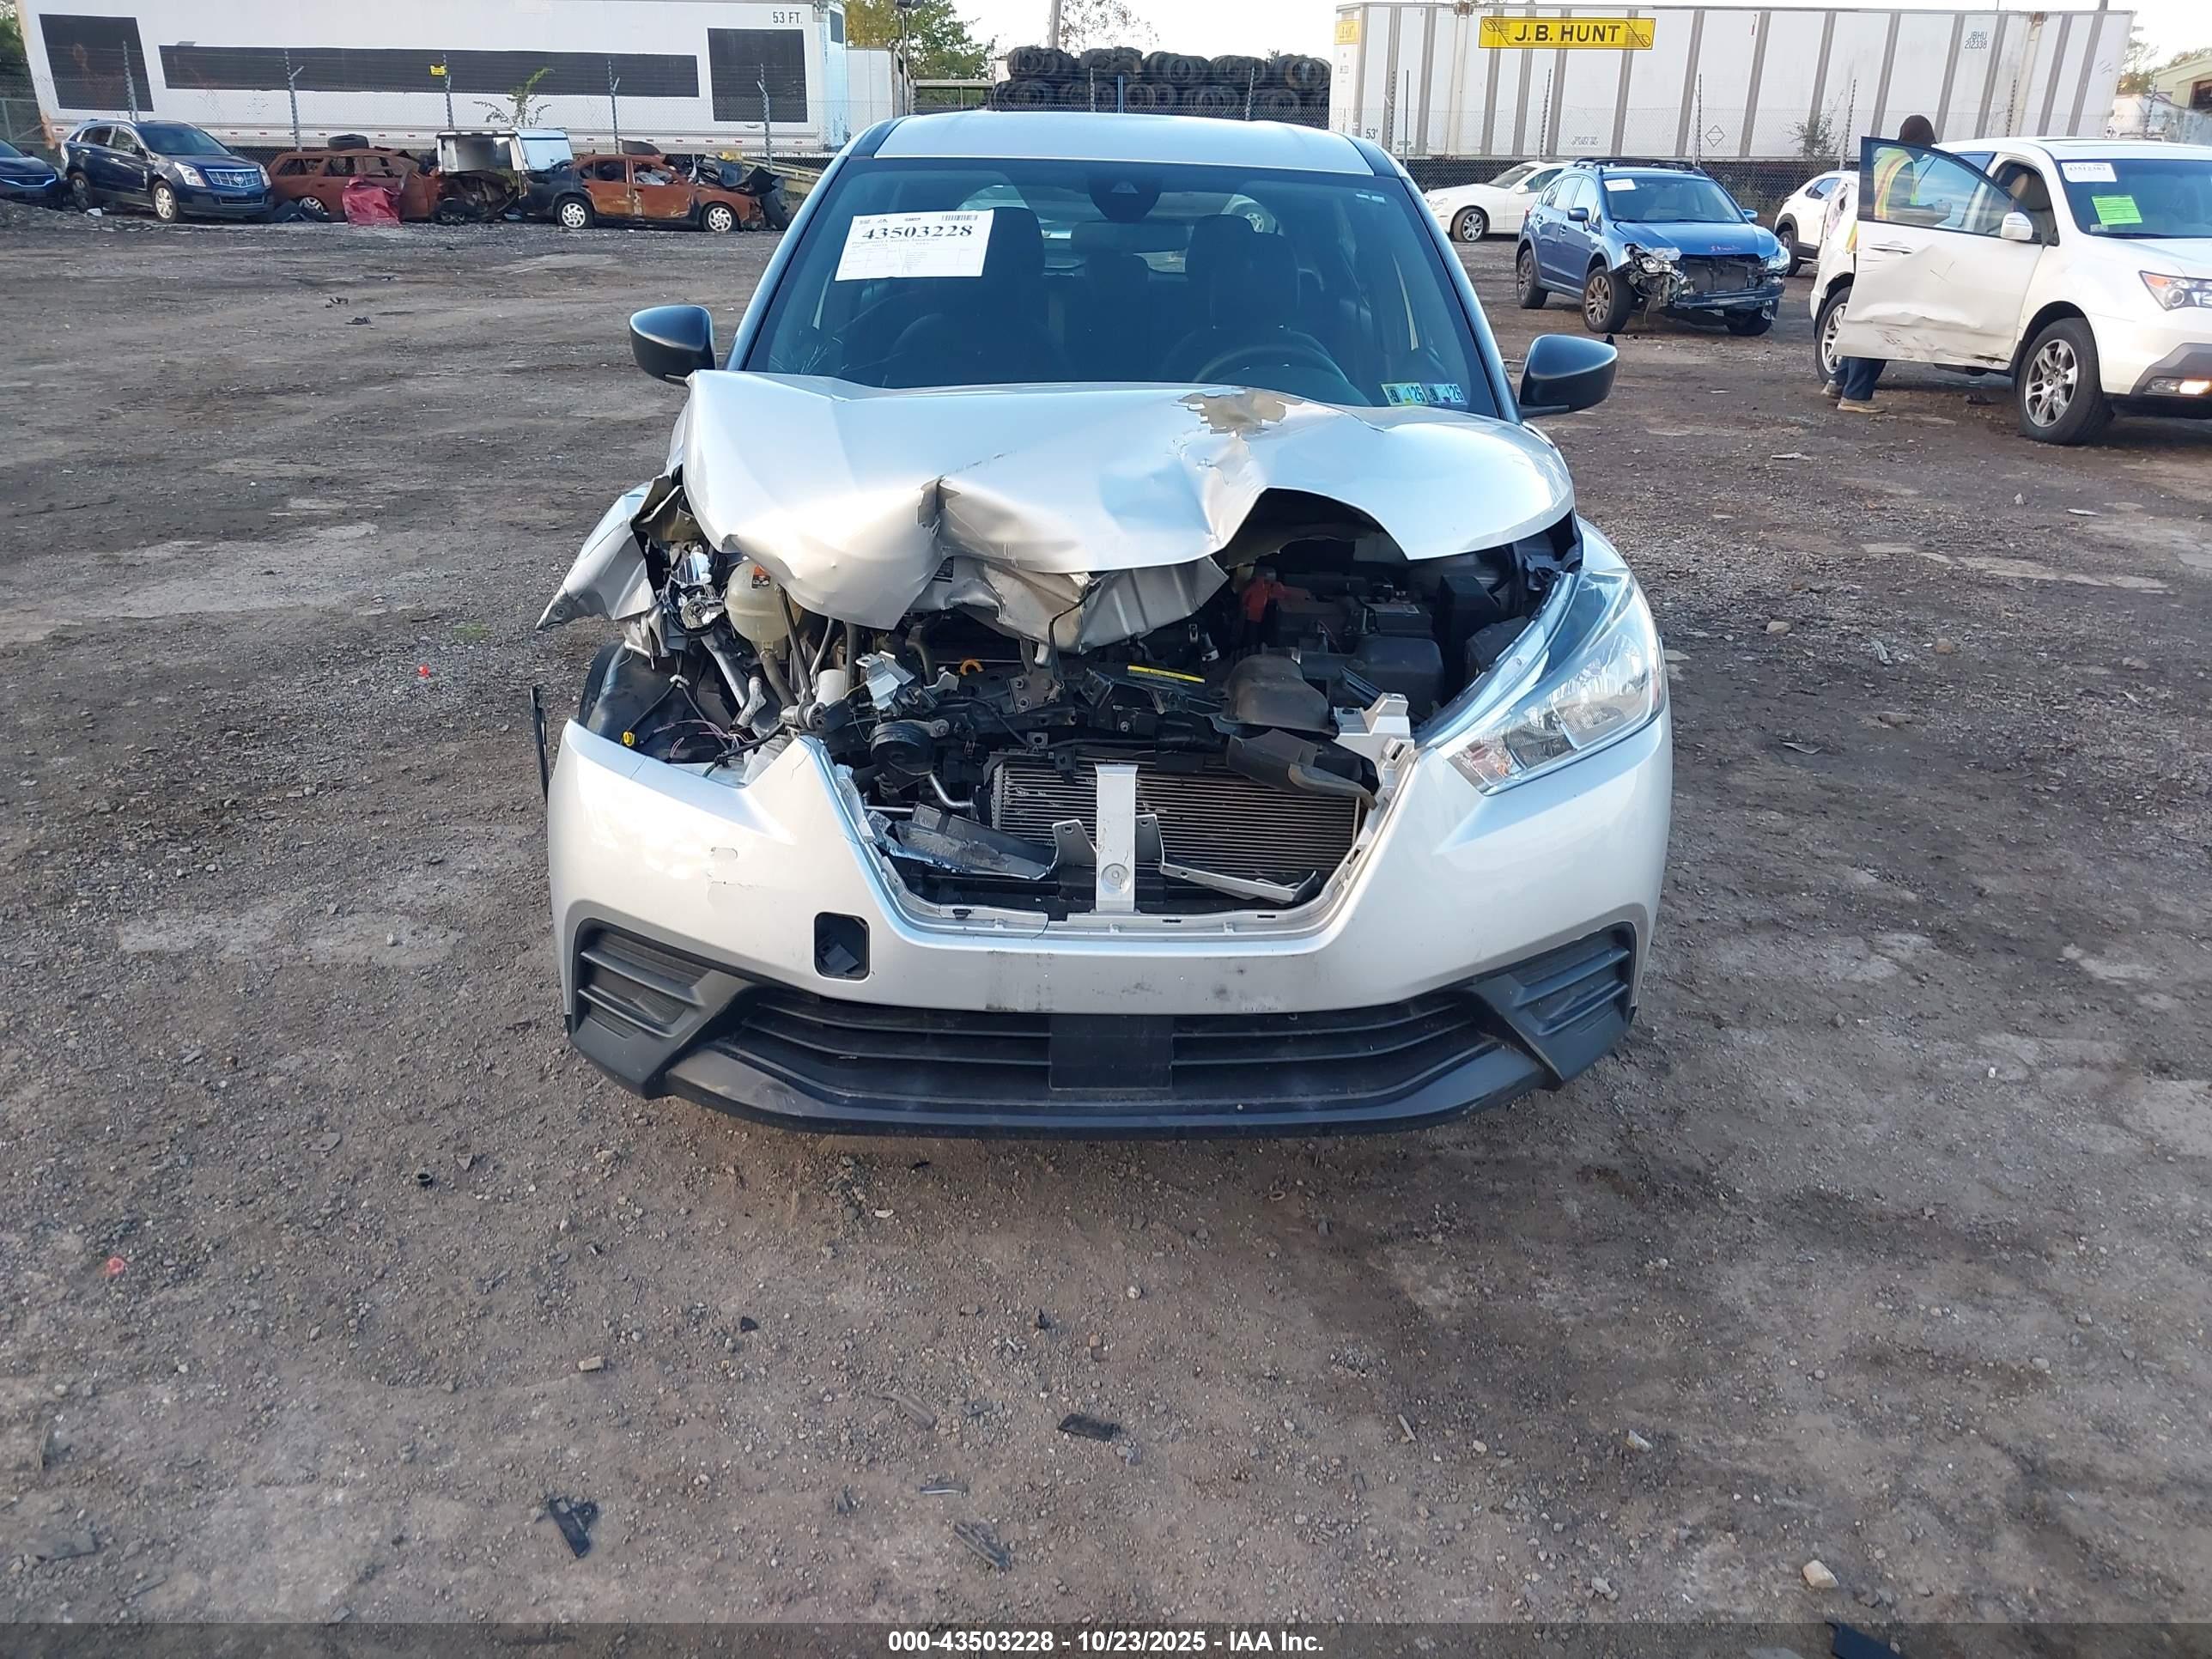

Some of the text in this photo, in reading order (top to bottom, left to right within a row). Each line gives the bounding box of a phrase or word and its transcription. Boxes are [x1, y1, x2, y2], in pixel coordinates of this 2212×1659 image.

[772, 11, 804, 25] 53 FT.
[1514, 24, 1621, 43] J.B. HUNT
[1968, 31, 1988, 40] JBHU
[1964, 40, 1988, 50] 212338
[862, 225, 974, 240] 43503228
[1390, 389, 1401, 404] 9
[1429, 387, 1439, 402] 9
